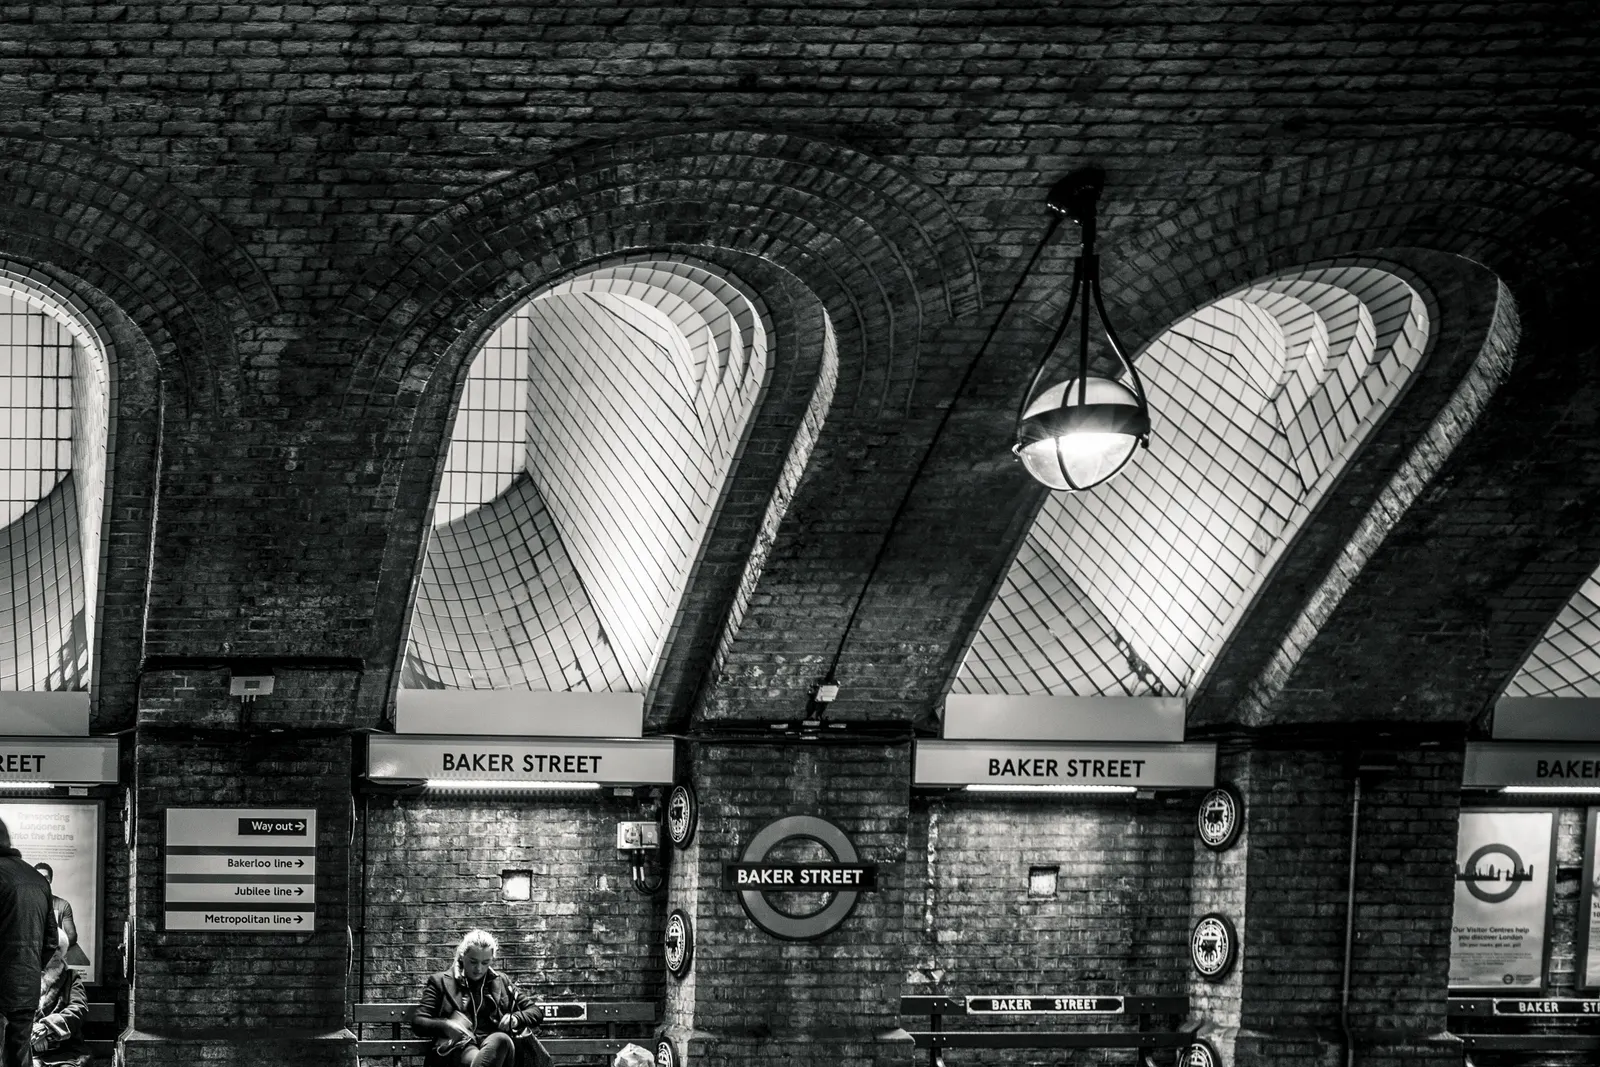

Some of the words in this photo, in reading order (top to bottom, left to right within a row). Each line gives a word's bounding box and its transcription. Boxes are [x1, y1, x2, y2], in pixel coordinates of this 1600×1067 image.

[442, 754, 514, 773] BAKER
[522, 754, 603, 773] STREET
[988, 758, 1058, 777] BAKER
[1067, 758, 1146, 777] STREET
[18, 812, 70, 822] Transporting
[20, 822, 66, 831] Londoners
[252, 821, 273, 832] Way
[275, 822, 293, 831] out
[31, 832, 45, 840] the
[47, 832, 74, 840] future
[228, 858, 270, 868] Bakerloo
[274, 858, 292, 868] line
[737, 870, 794, 884] BAKER
[800, 870, 864, 884] STREET
[234, 886, 270, 896] Jubilee
[274, 886, 292, 896] line
[205, 914, 270, 925] Metropolitan
[273, 914, 292, 924] line
[992, 999, 1032, 1010] BAKER
[1054, 999, 1098, 1010] STREET
[1519, 1002, 1558, 1012] BAKER
